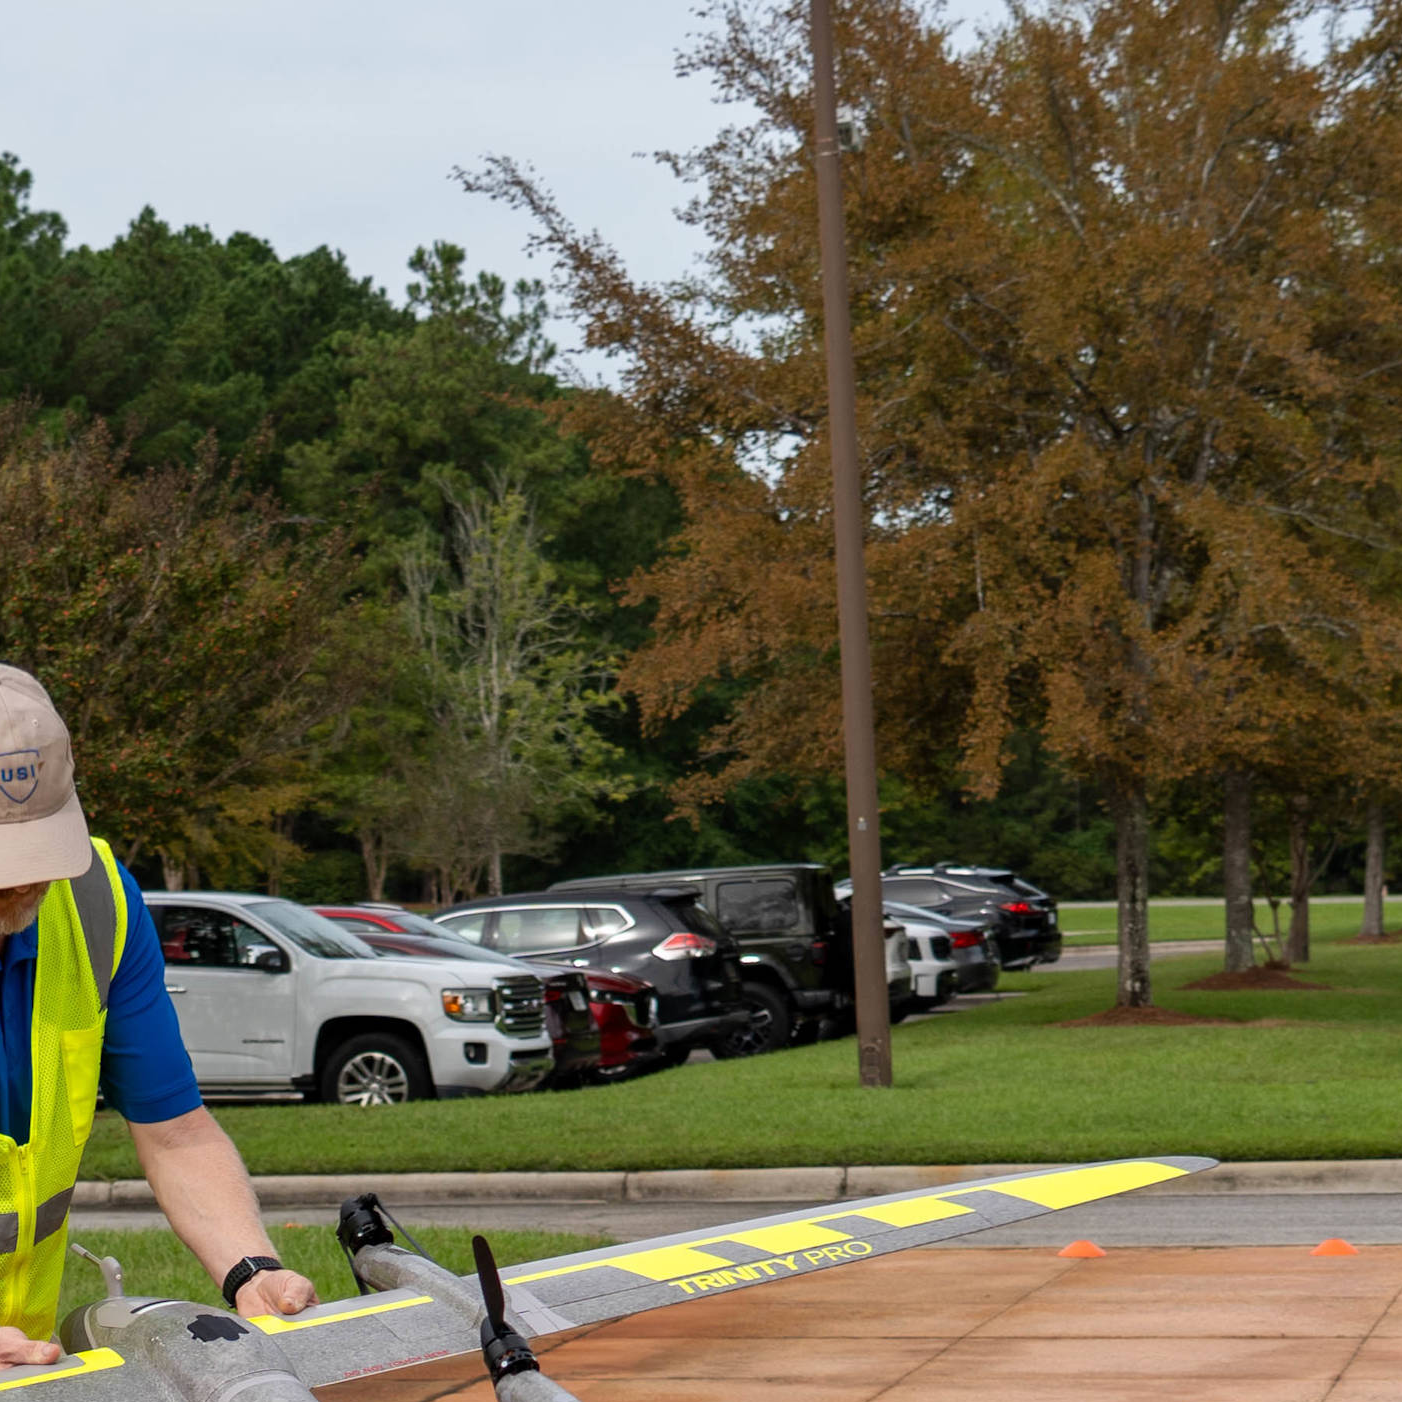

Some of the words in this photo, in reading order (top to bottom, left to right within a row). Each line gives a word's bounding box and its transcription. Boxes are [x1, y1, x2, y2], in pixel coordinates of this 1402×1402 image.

[0, 763, 36, 783] USI
[668, 1254, 799, 1294] TRINITY
[802, 1241, 873, 1266] PRO
